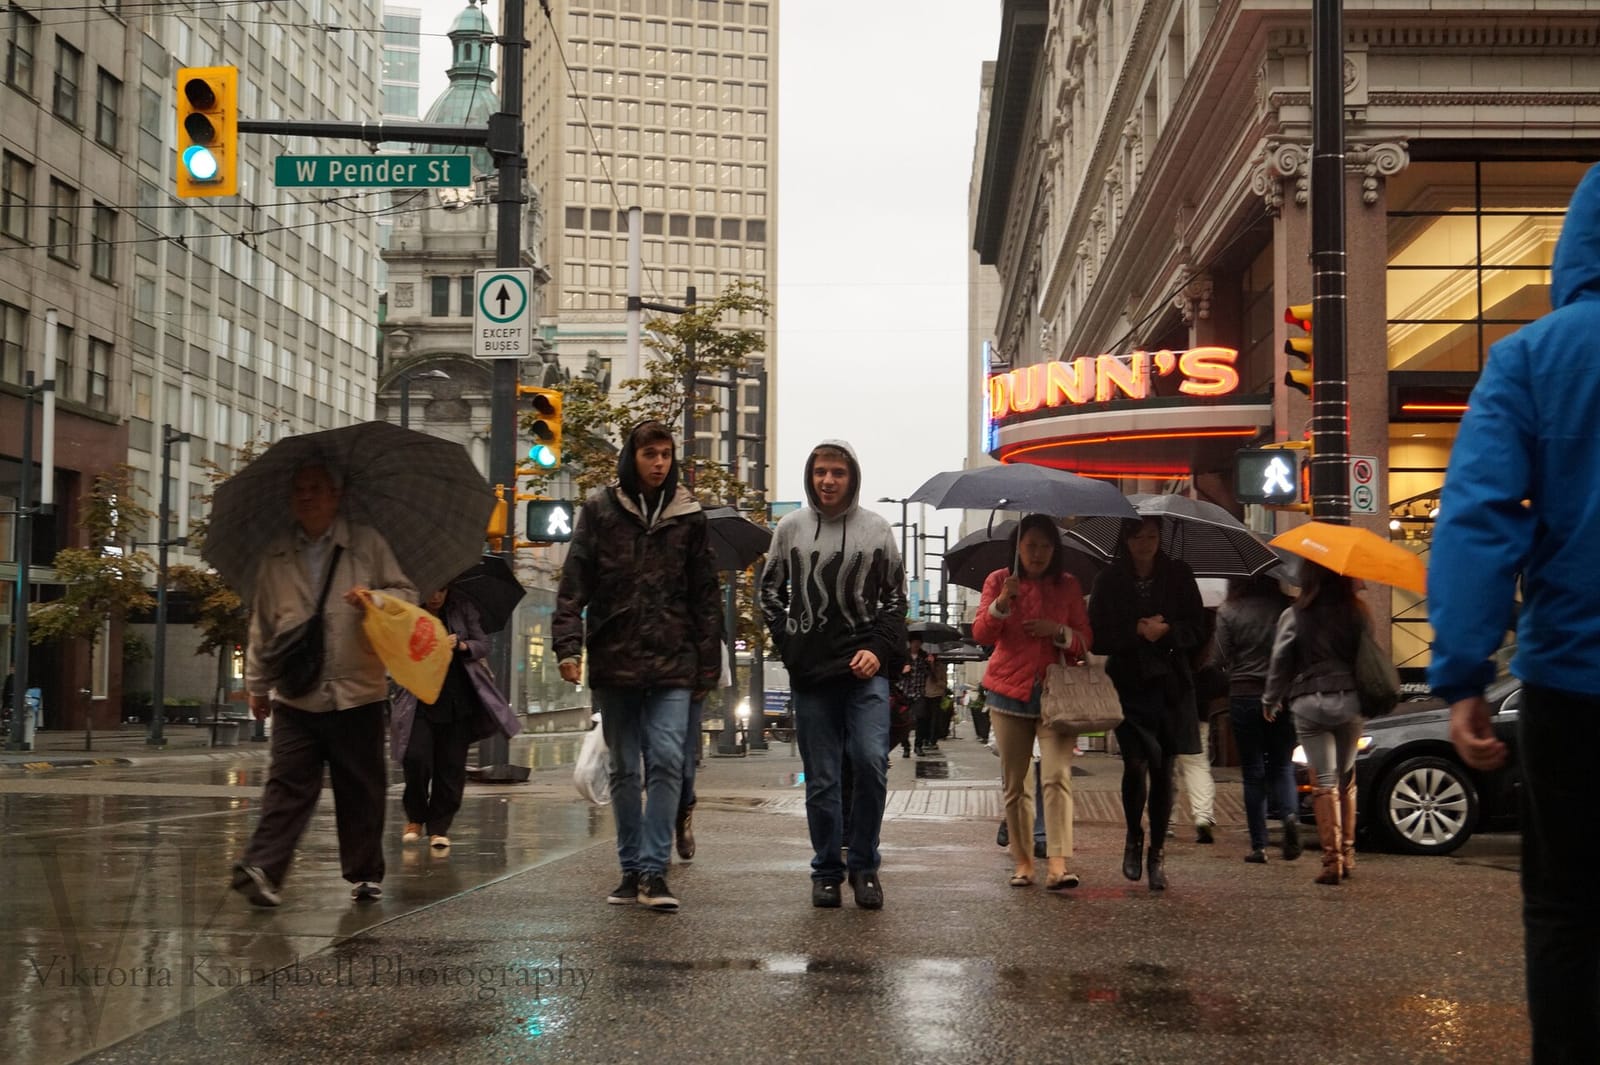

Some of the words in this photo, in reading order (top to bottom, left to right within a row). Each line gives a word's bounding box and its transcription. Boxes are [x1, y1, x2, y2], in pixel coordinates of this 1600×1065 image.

[296, 160, 317, 182] W
[328, 159, 417, 183] Pender
[427, 160, 451, 183] St
[482, 328, 522, 338] EXCEPT
[485, 341, 520, 351] BUSES
[990, 346, 1240, 418] DUNN'S
